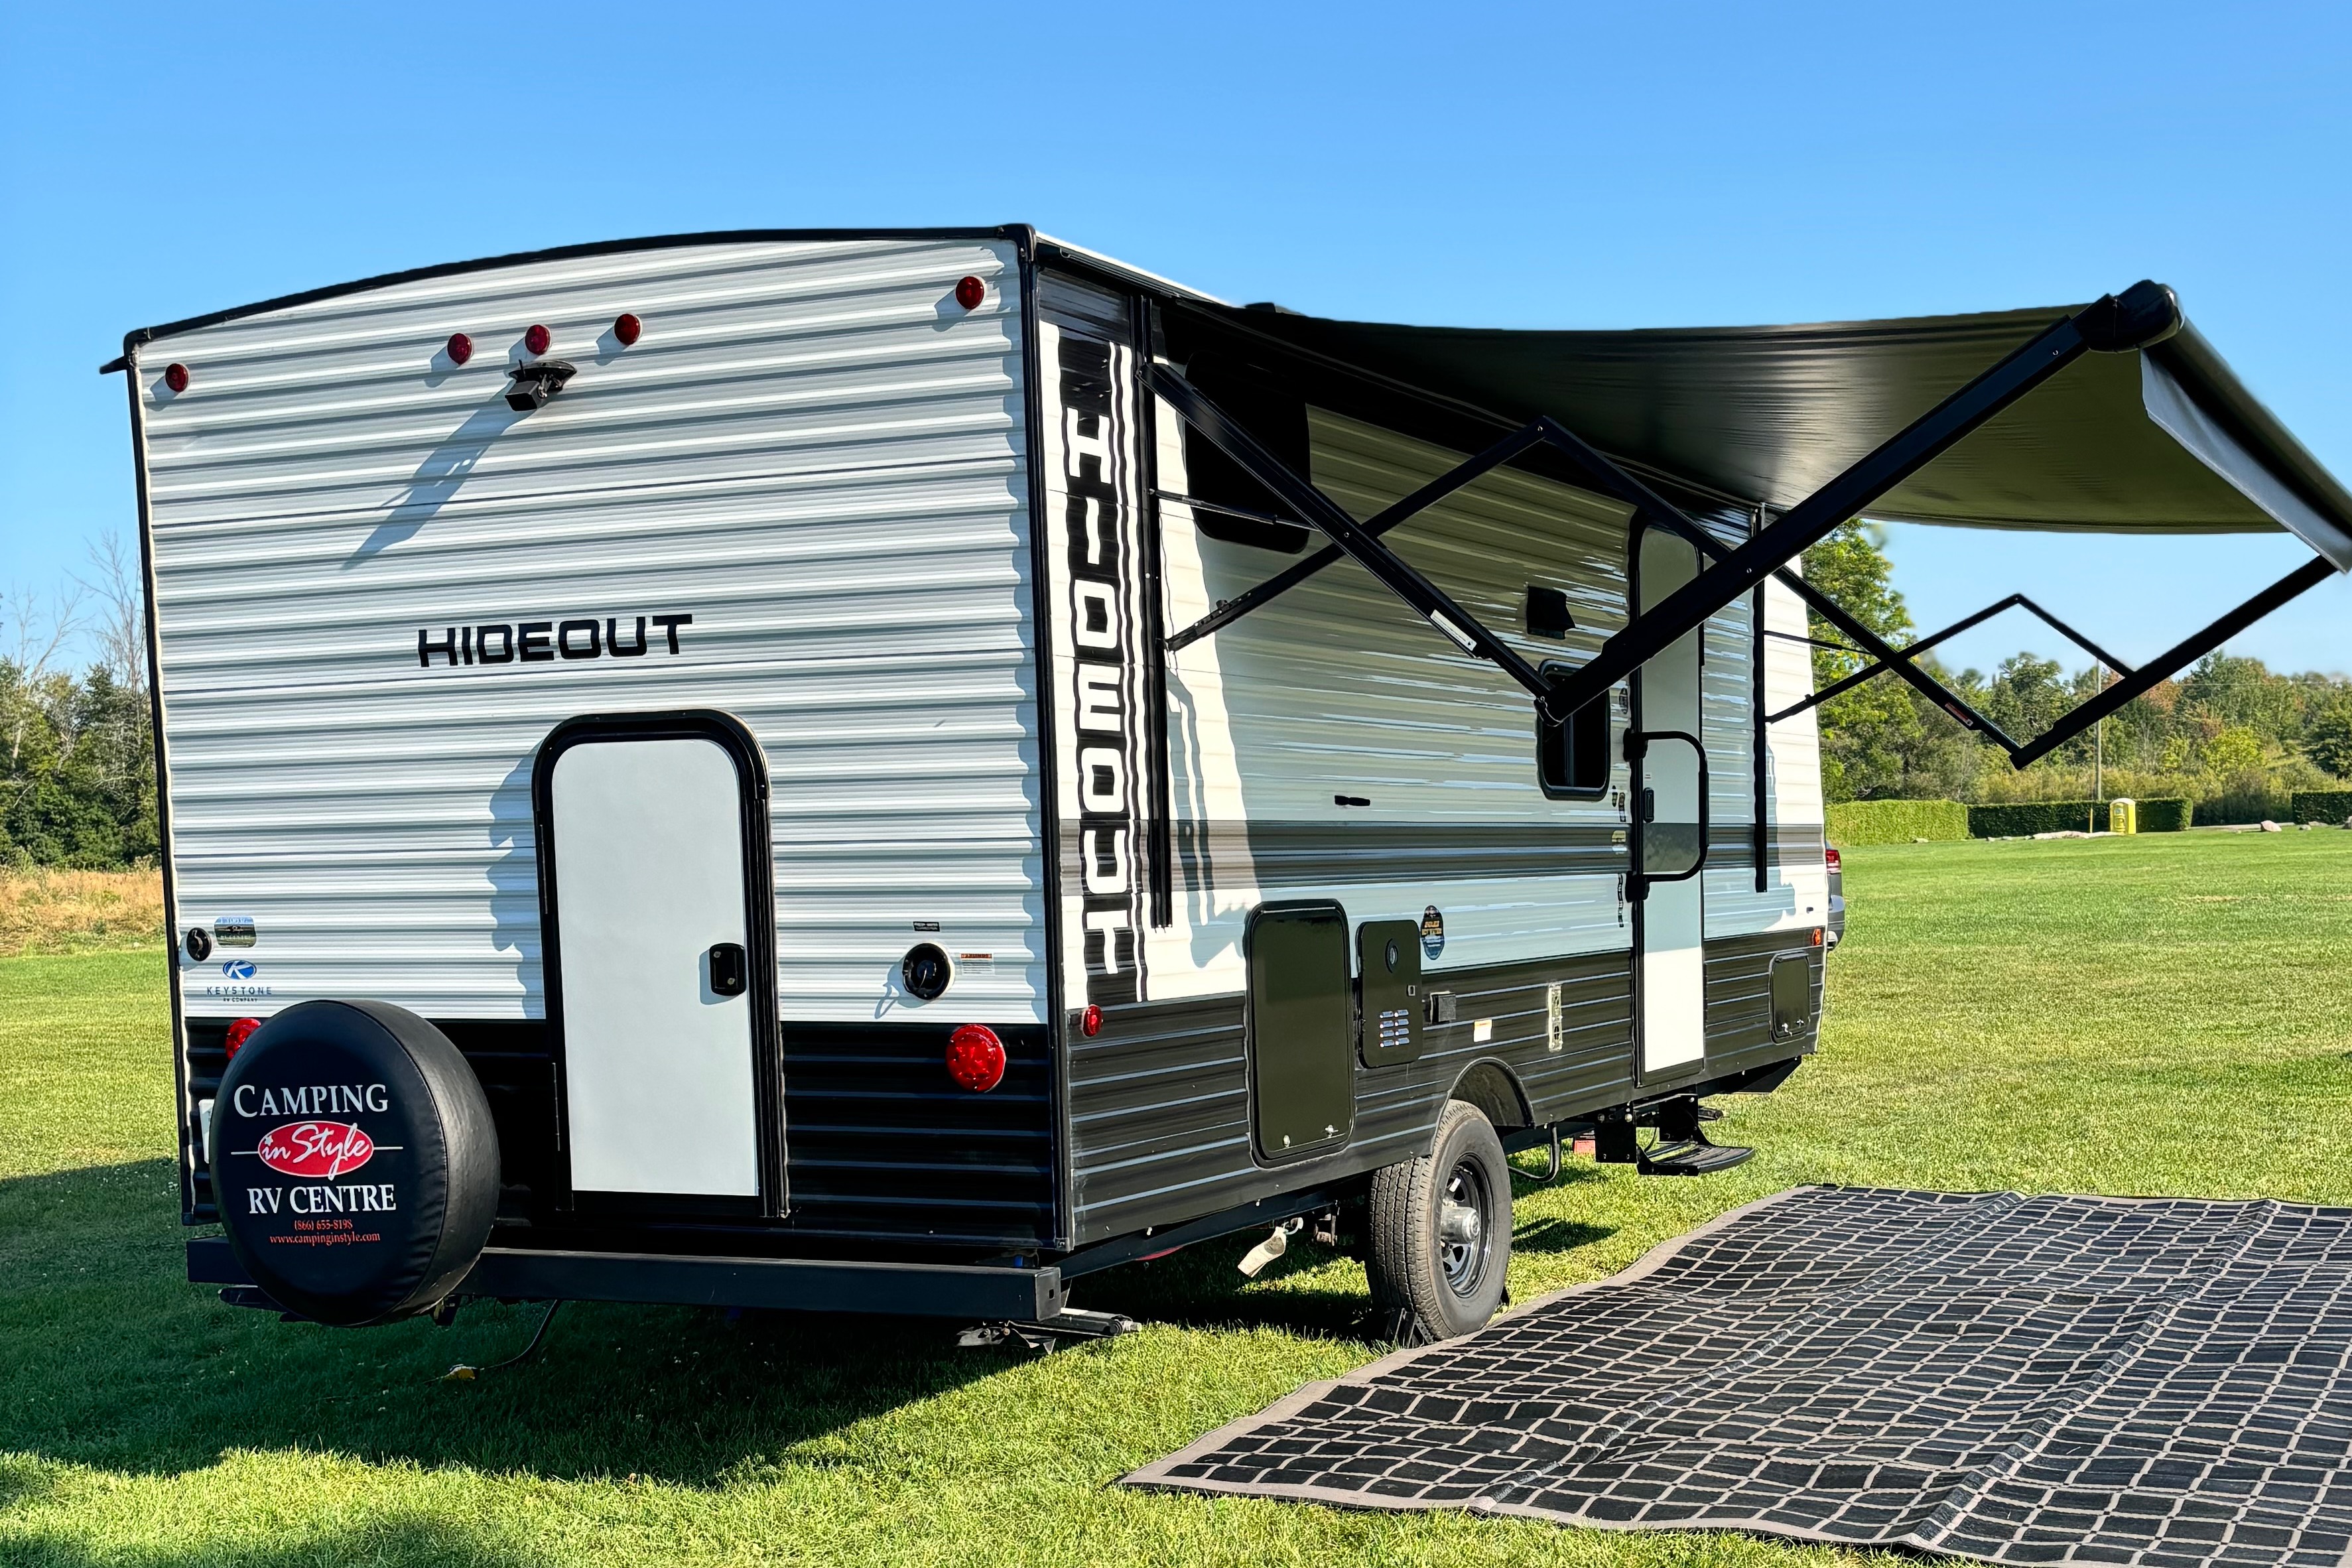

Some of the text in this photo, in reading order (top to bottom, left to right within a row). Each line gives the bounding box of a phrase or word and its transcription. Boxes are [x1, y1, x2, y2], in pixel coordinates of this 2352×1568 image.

[418, 614, 692, 667] HIDEOUT
[1066, 407, 1130, 974] HIDEOUT
[207, 986, 272, 995] KEYSTONE
[233, 1084, 389, 1118] CAMPING
[261, 1122, 370, 1181] in Style
[247, 1184, 397, 1214] RV CENTRE
[269, 1231, 381, 1247] www.campinginstyle.com
[294, 1220, 314, 1231] (866)
